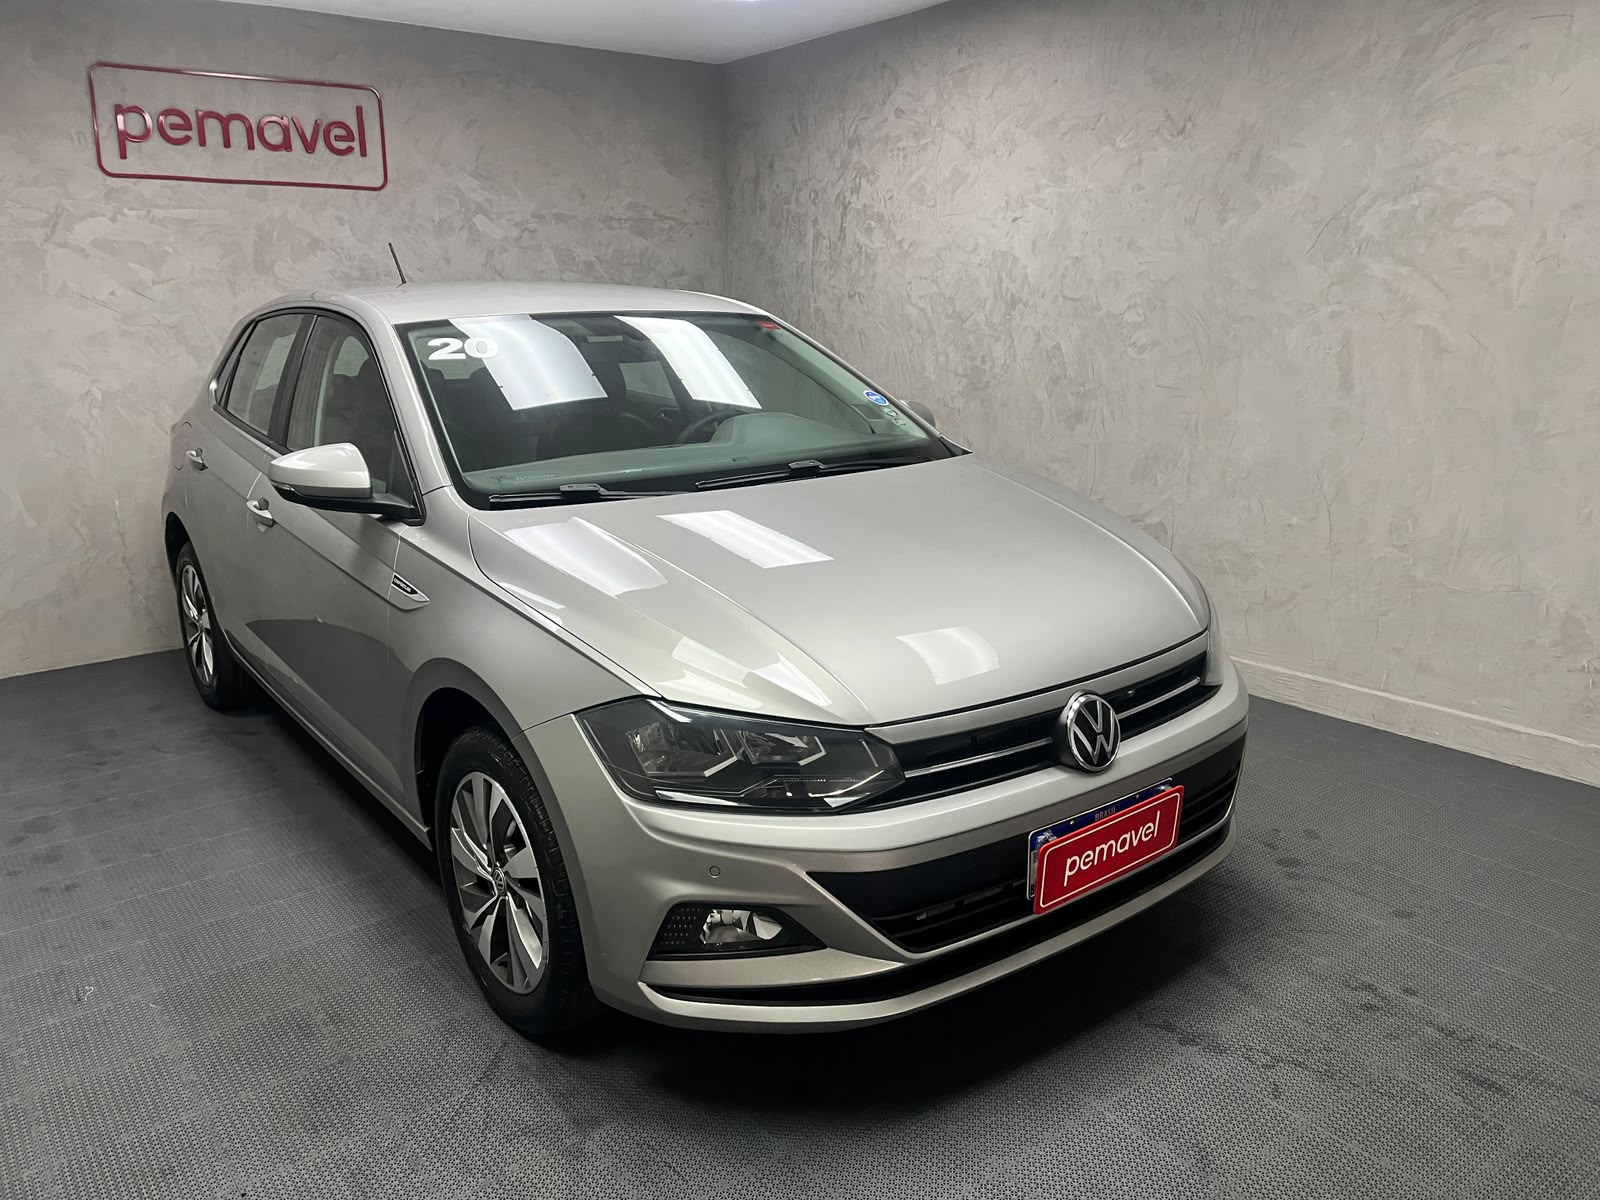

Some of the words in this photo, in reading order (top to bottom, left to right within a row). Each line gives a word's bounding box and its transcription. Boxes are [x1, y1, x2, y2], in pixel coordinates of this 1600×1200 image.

[114, 103, 368, 160] pemavel
[427, 337, 499, 360] 20
[1064, 810, 1161, 887] pemavel
